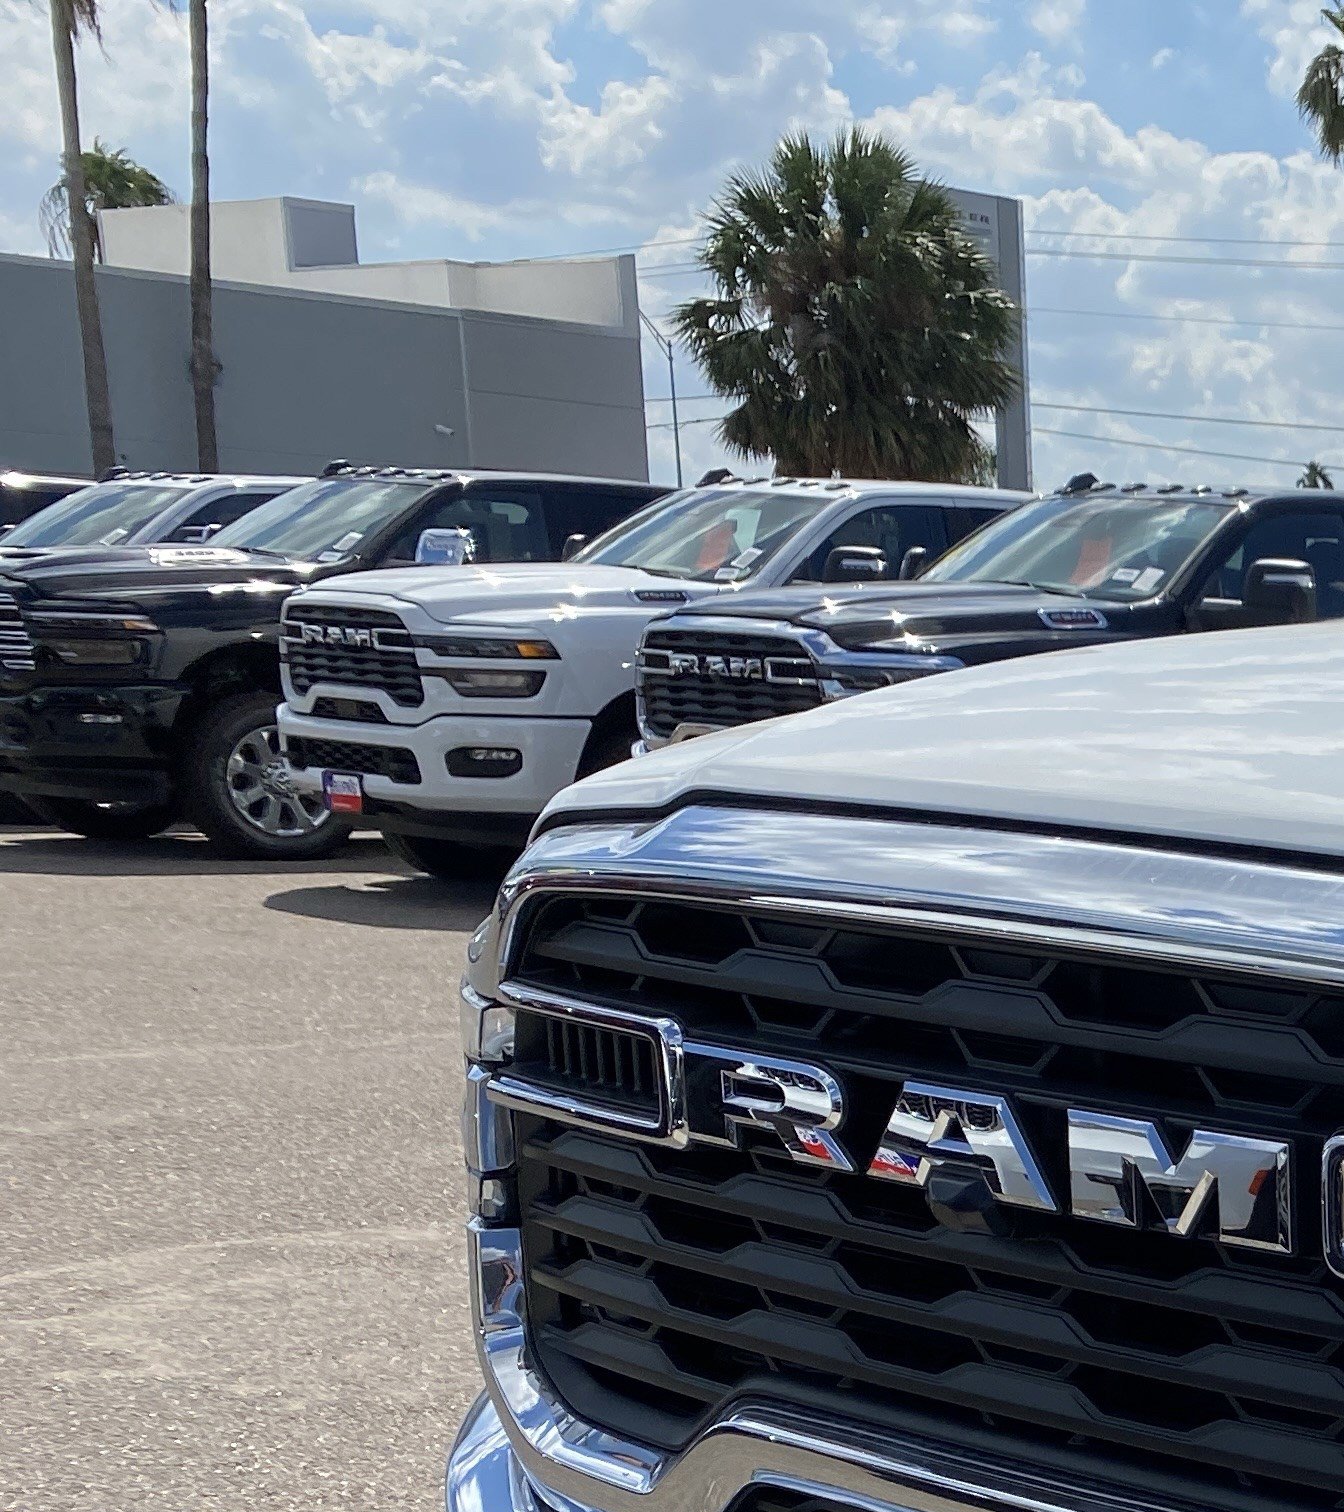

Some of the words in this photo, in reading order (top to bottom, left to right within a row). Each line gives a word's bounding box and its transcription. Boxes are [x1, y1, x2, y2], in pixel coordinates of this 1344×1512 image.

[301, 624, 371, 647] RAM
[669, 652, 762, 679] RAM
[684, 1041, 1294, 1255] RAM
